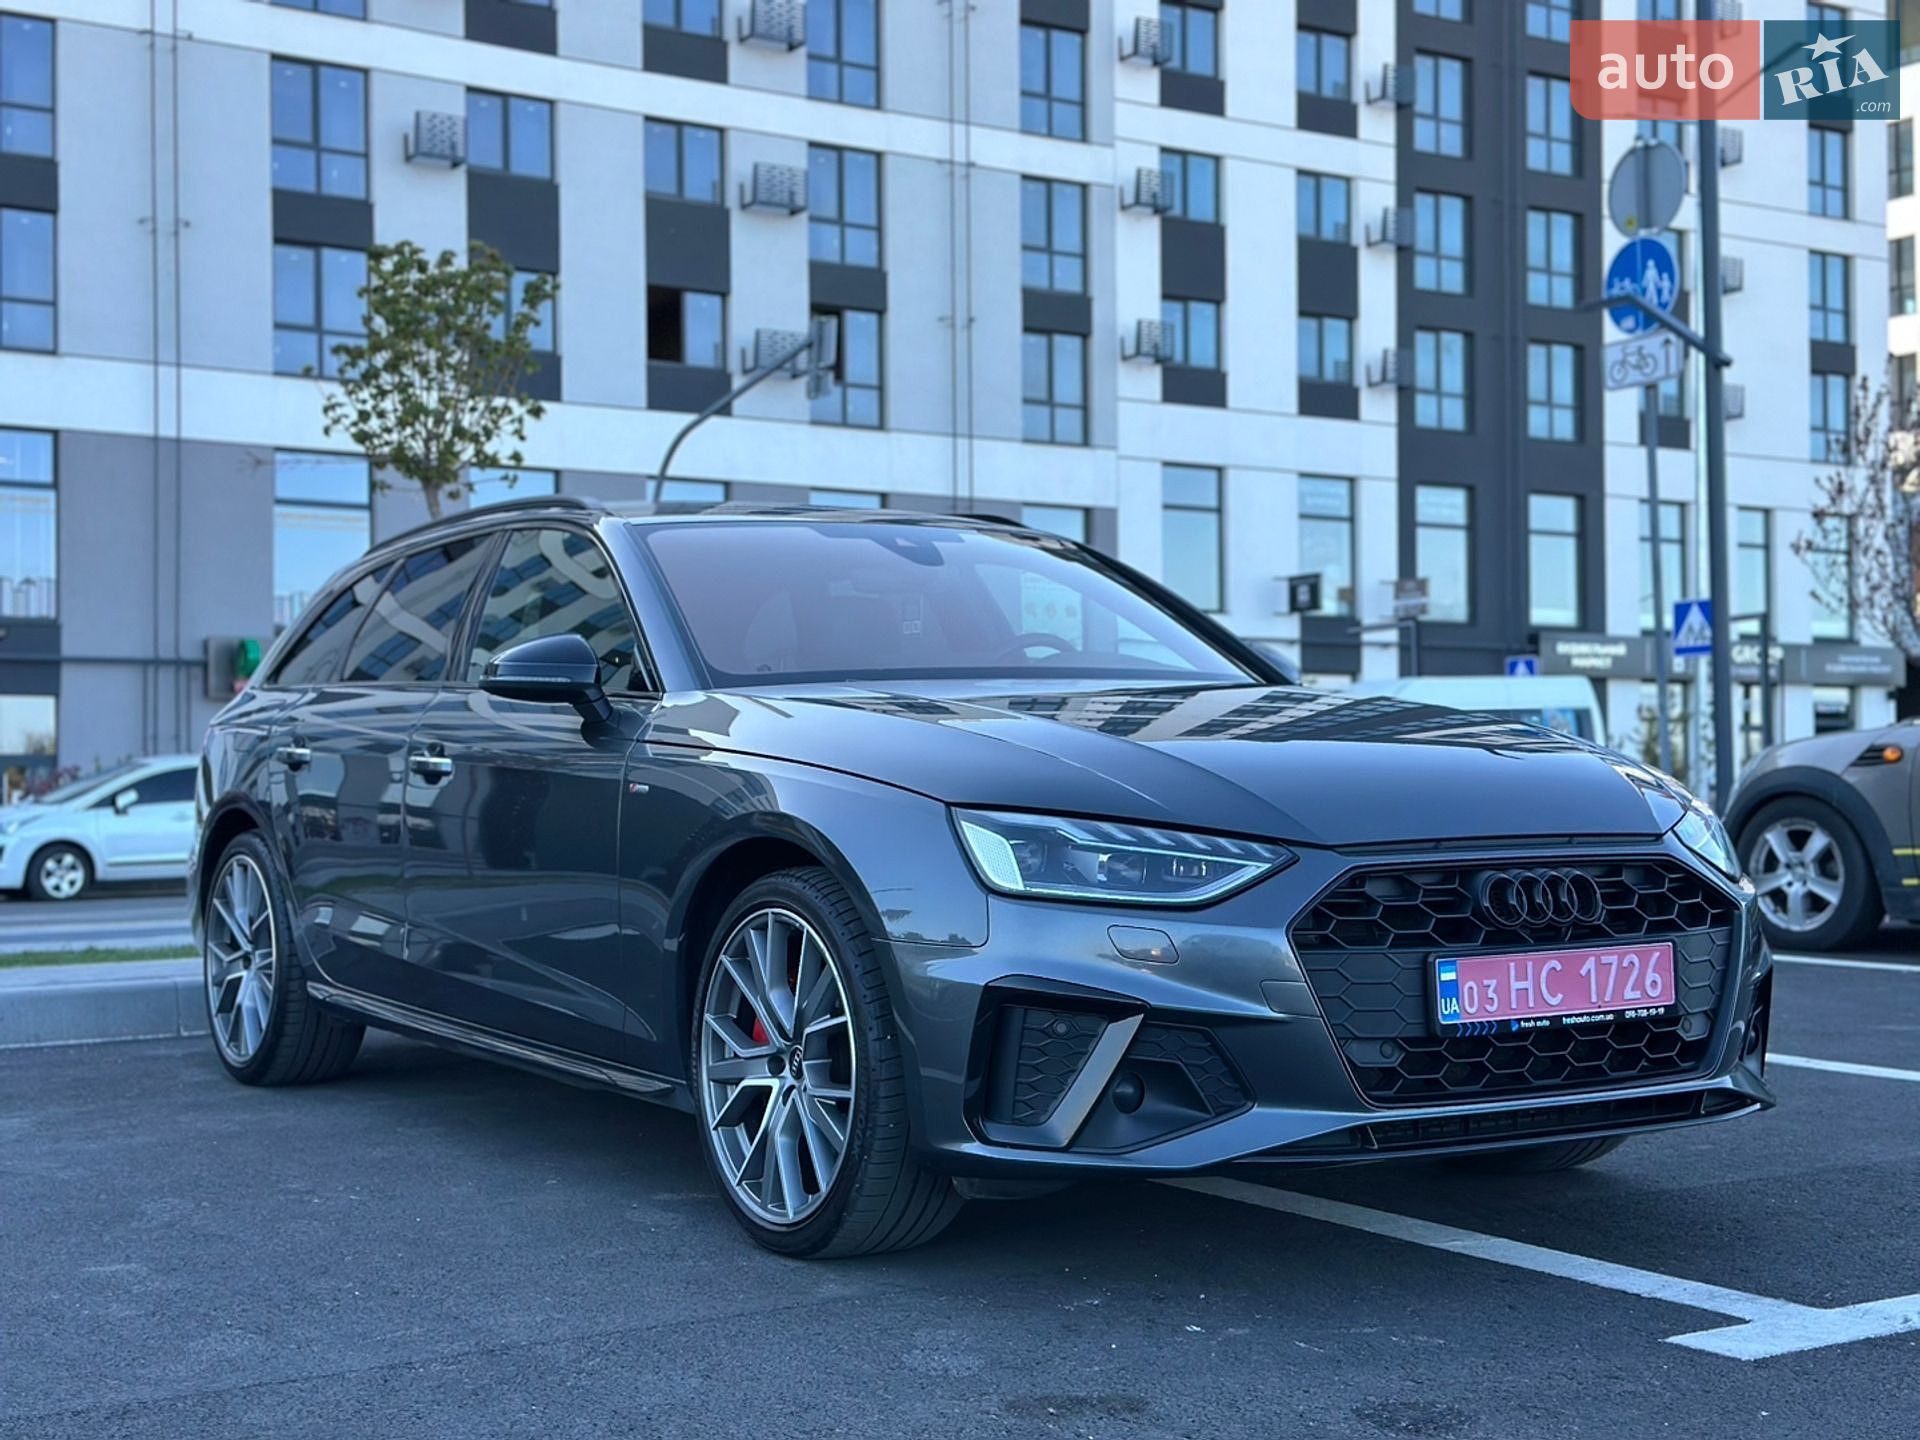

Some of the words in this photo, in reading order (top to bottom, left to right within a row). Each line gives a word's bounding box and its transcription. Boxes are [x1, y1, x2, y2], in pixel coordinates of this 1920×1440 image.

[1463, 979, 1498, 1014] 03
[1509, 959, 1564, 1009] HC
[1579, 951, 1663, 1004] 1726
[1441, 997, 1460, 1015] UA
